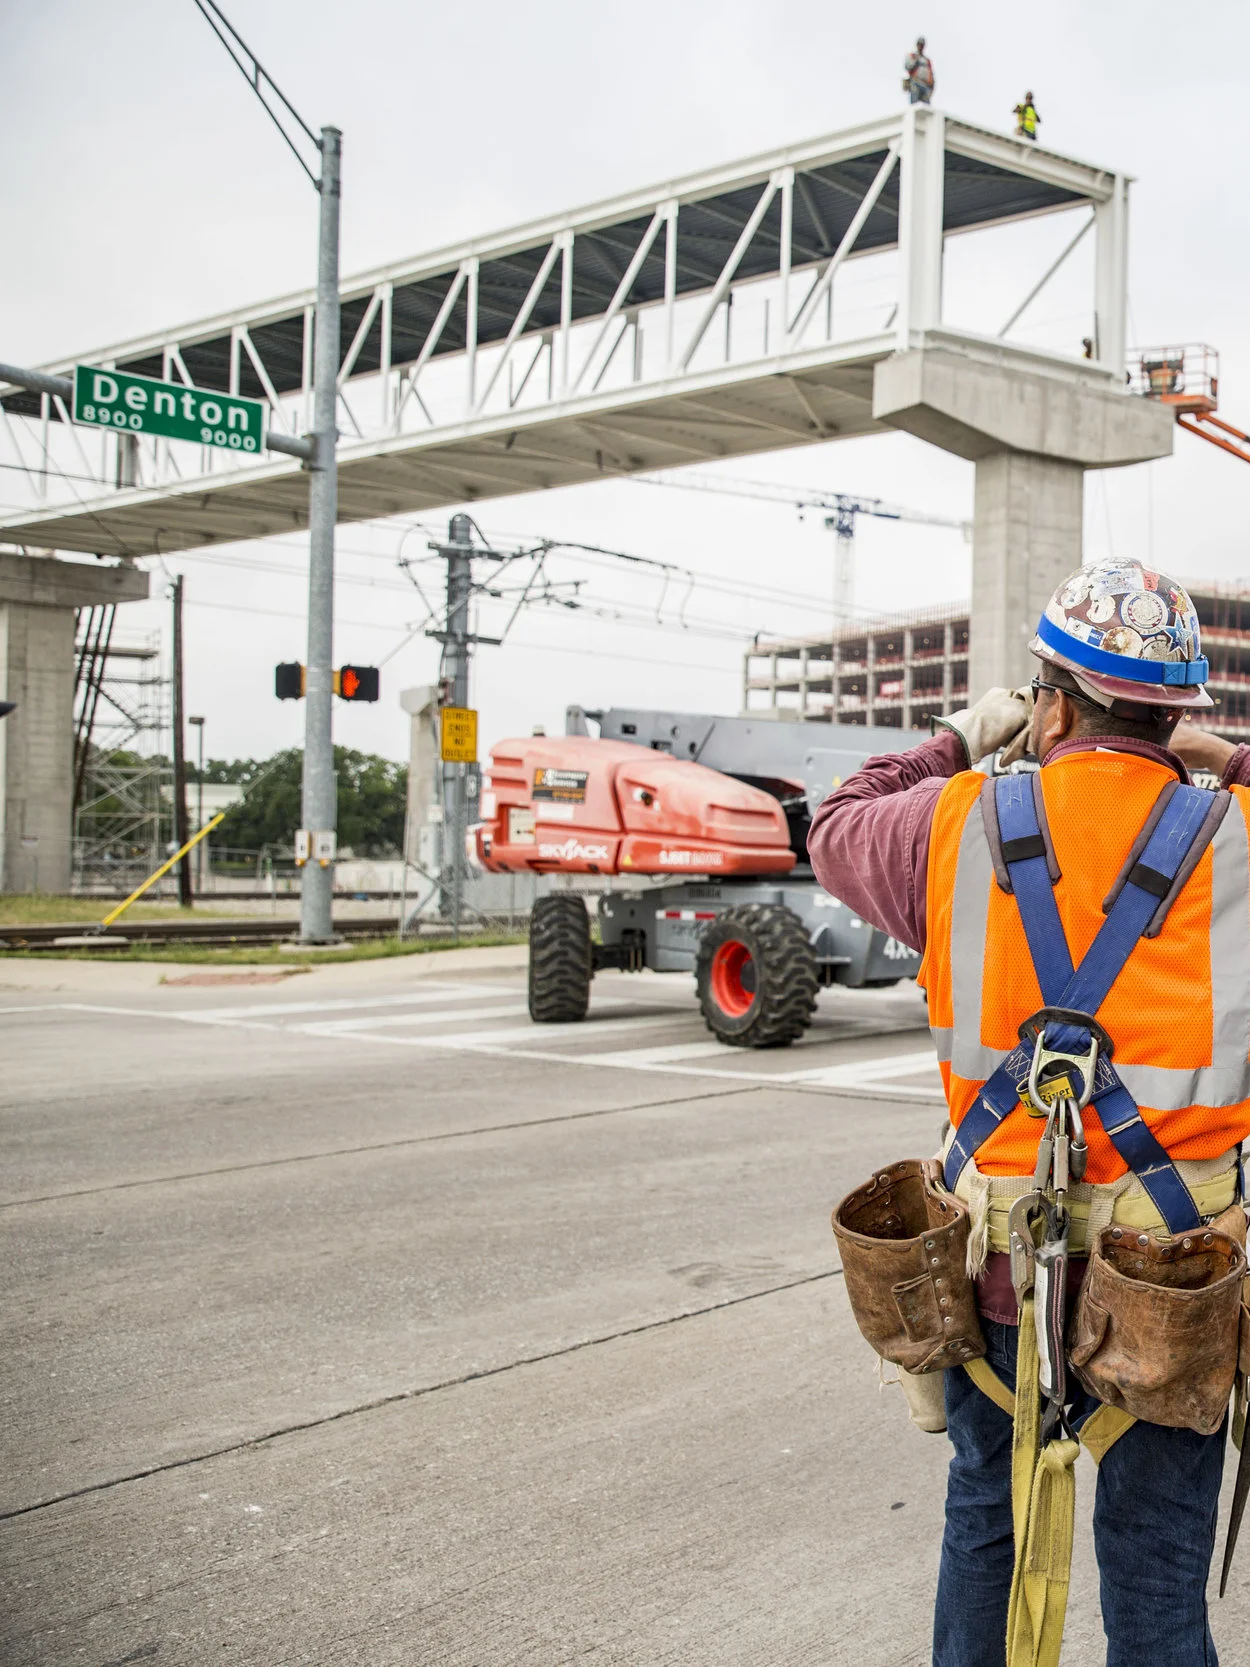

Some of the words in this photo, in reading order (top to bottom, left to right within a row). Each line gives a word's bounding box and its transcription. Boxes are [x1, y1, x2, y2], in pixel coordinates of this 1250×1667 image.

[92, 373, 249, 432] Denton
[82, 404, 143, 430] 8900
[200, 427, 257, 451] 9000
[538, 839, 609, 860] SKYJACK
[1040, 1087, 1071, 1104] River
